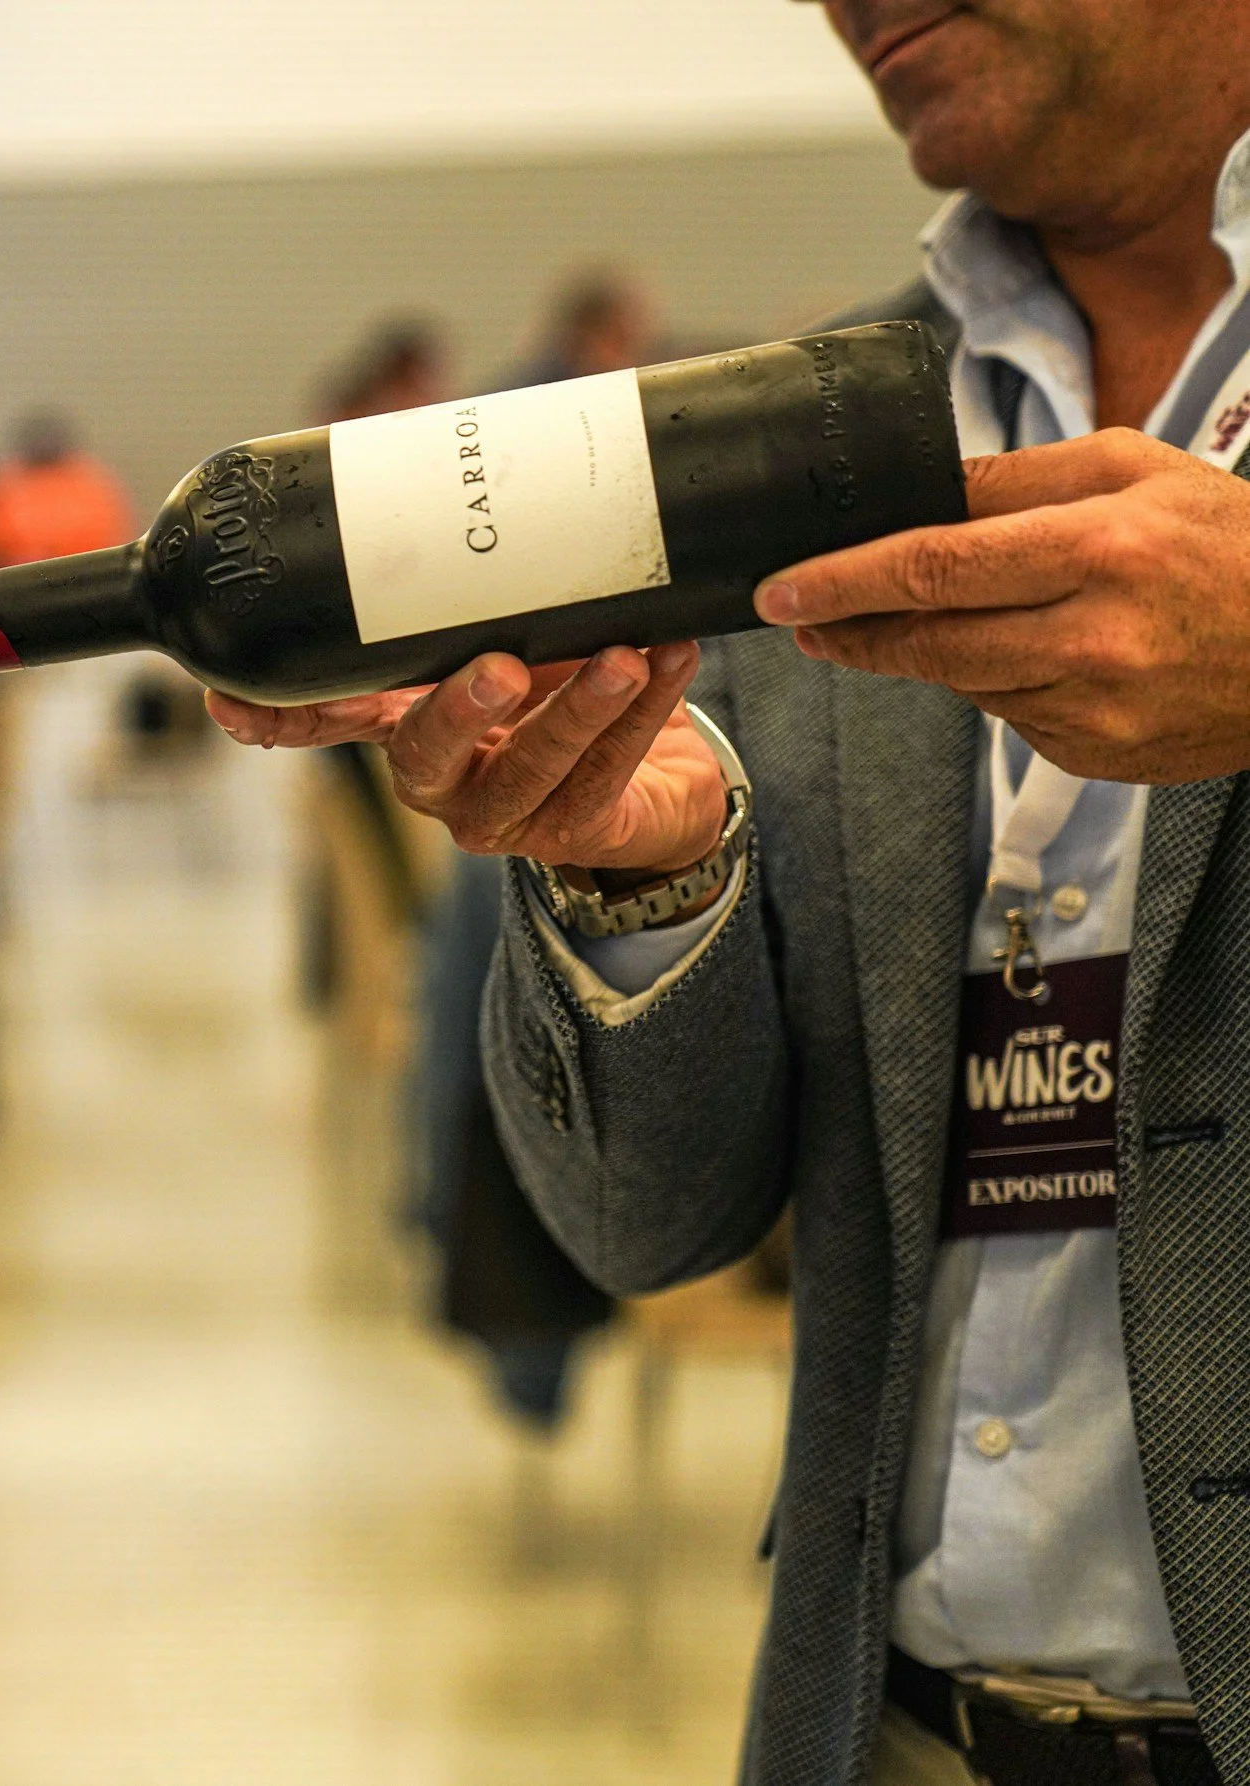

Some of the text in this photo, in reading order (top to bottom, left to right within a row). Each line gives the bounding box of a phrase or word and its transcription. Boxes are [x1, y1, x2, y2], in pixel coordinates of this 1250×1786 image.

[455, 406, 498, 553] CARROA
[967, 1038, 1113, 1110] WINES
[969, 1170, 1118, 1207] EXPOSITOR
